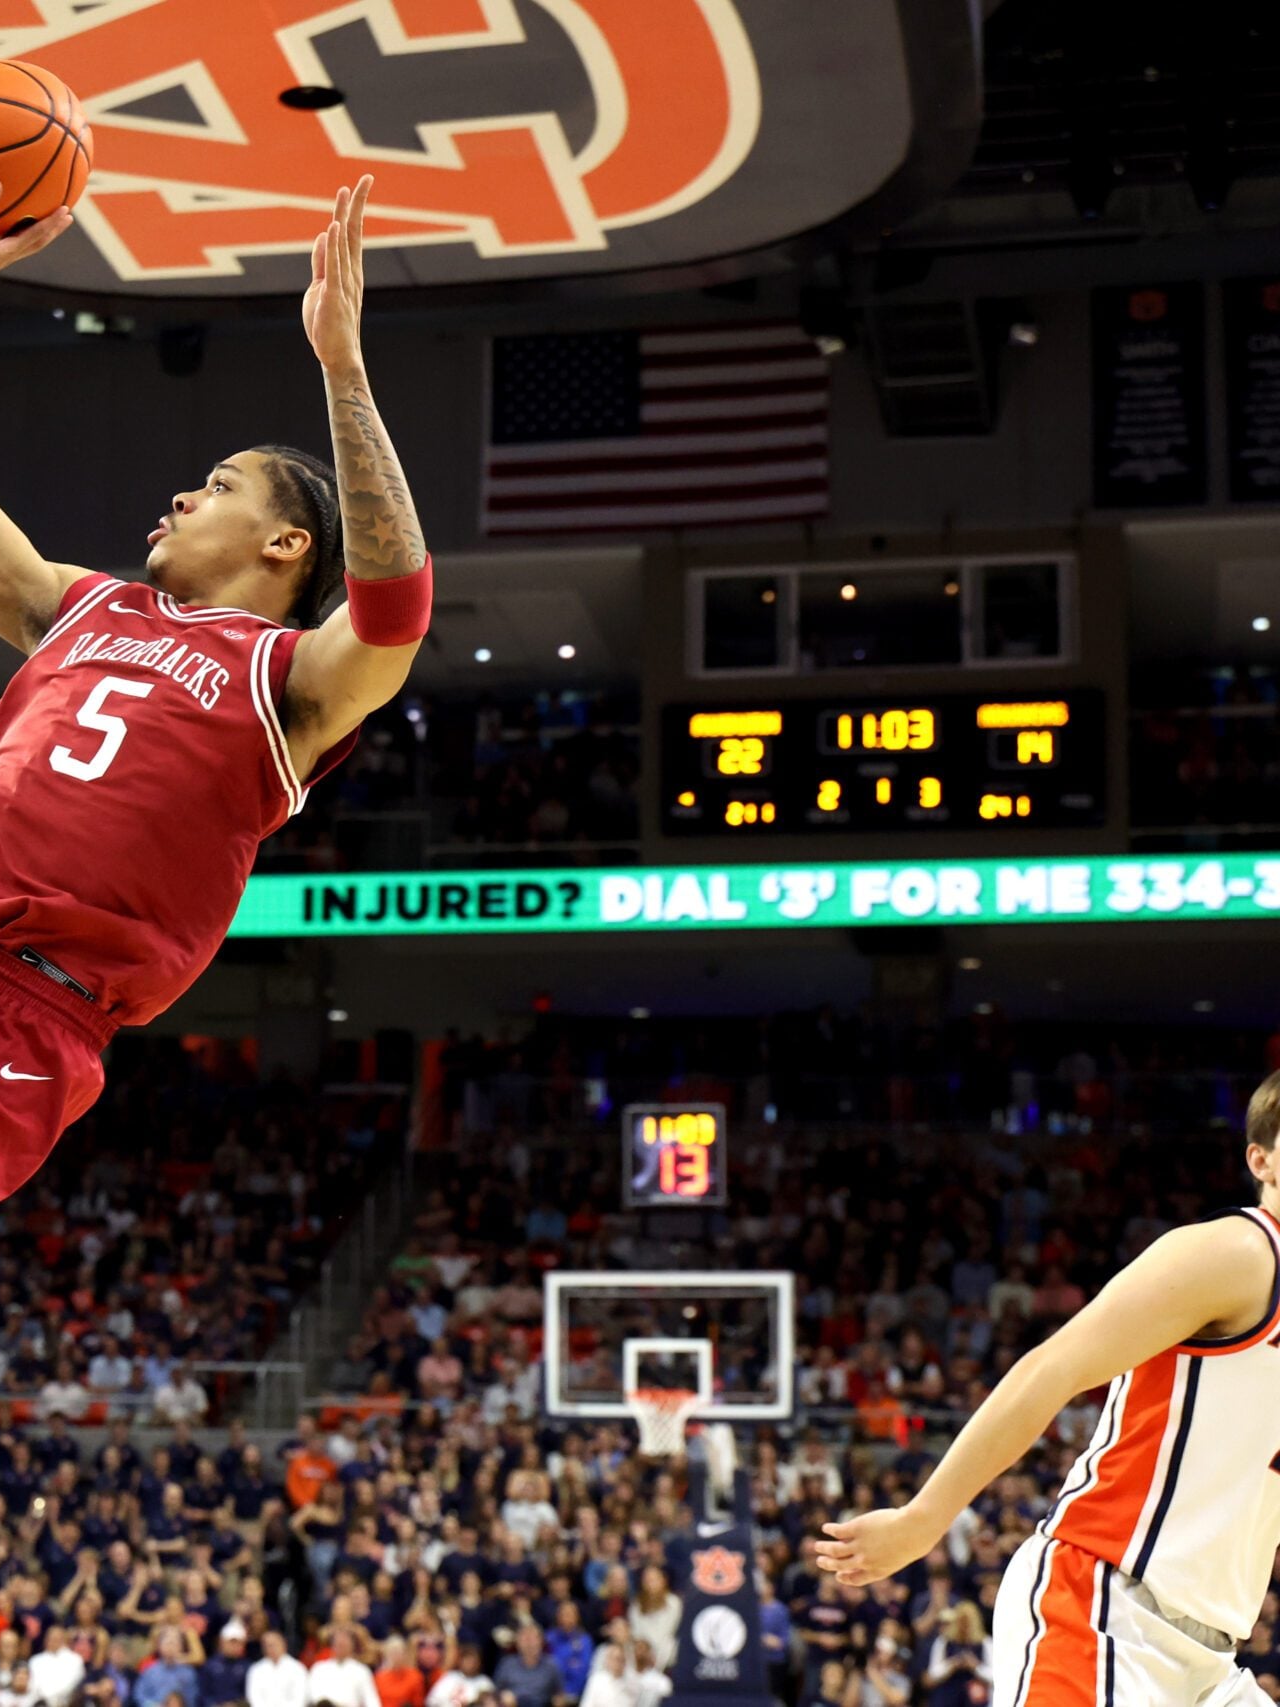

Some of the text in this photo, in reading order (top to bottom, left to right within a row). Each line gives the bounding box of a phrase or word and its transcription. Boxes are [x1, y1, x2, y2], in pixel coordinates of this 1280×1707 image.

[58, 632, 230, 711] RAZORBACKS
[49, 676, 155, 782] 5
[717, 738, 764, 774] 22
[837, 709, 934, 751] 11:03
[302, 881, 582, 922] INJURED?
[600, 873, 747, 923] DIAL
[850, 867, 982, 918] FOR
[996, 864, 1091, 915] ME
[659, 1143, 710, 1196] 13
